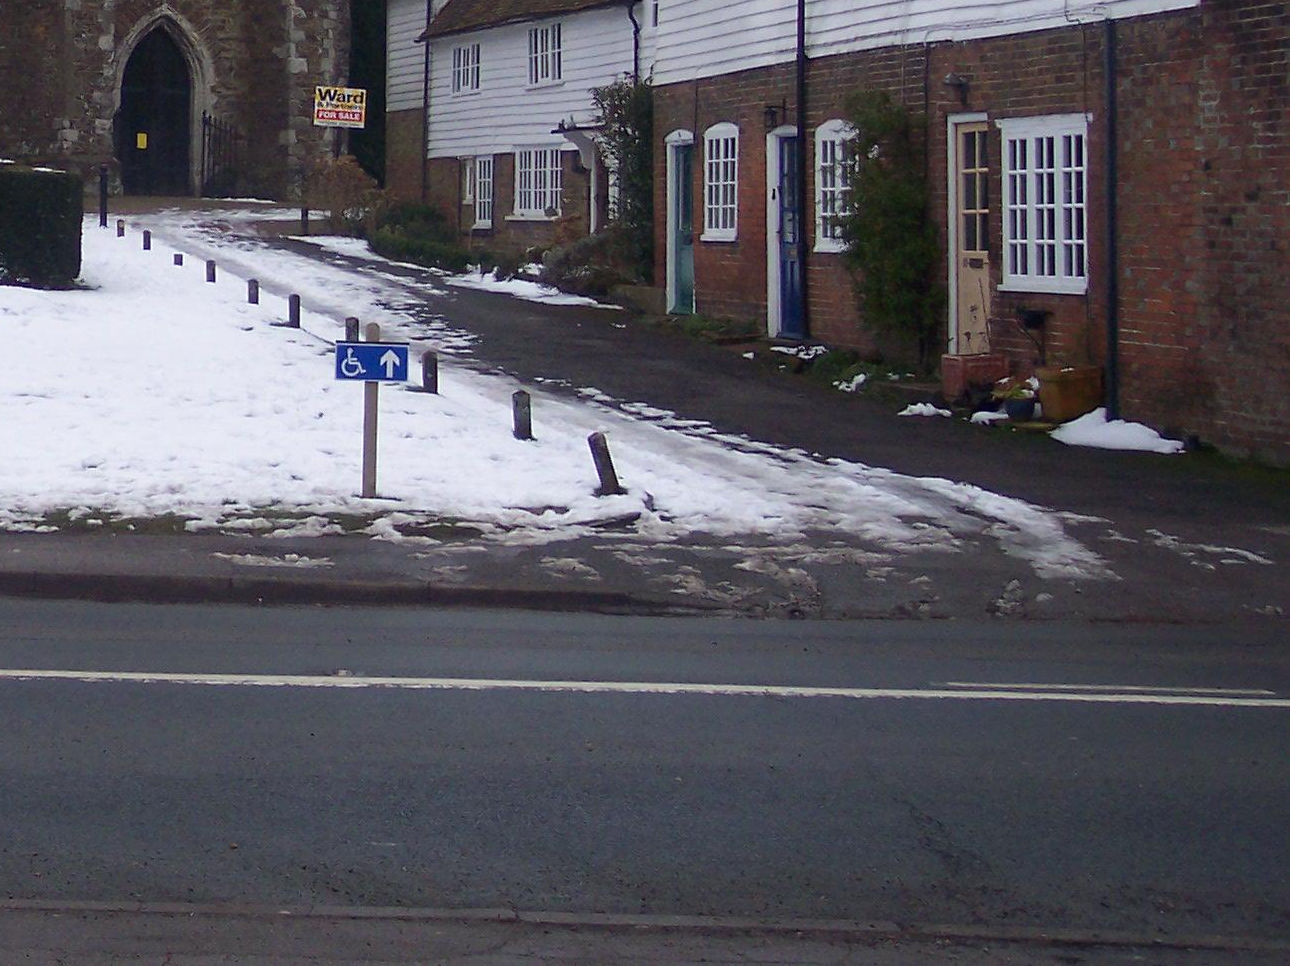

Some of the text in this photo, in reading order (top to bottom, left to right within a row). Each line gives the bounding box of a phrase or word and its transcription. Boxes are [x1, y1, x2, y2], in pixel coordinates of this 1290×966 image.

[318, 88, 364, 104] Ward
[318, 110, 361, 121] FOR SALE
